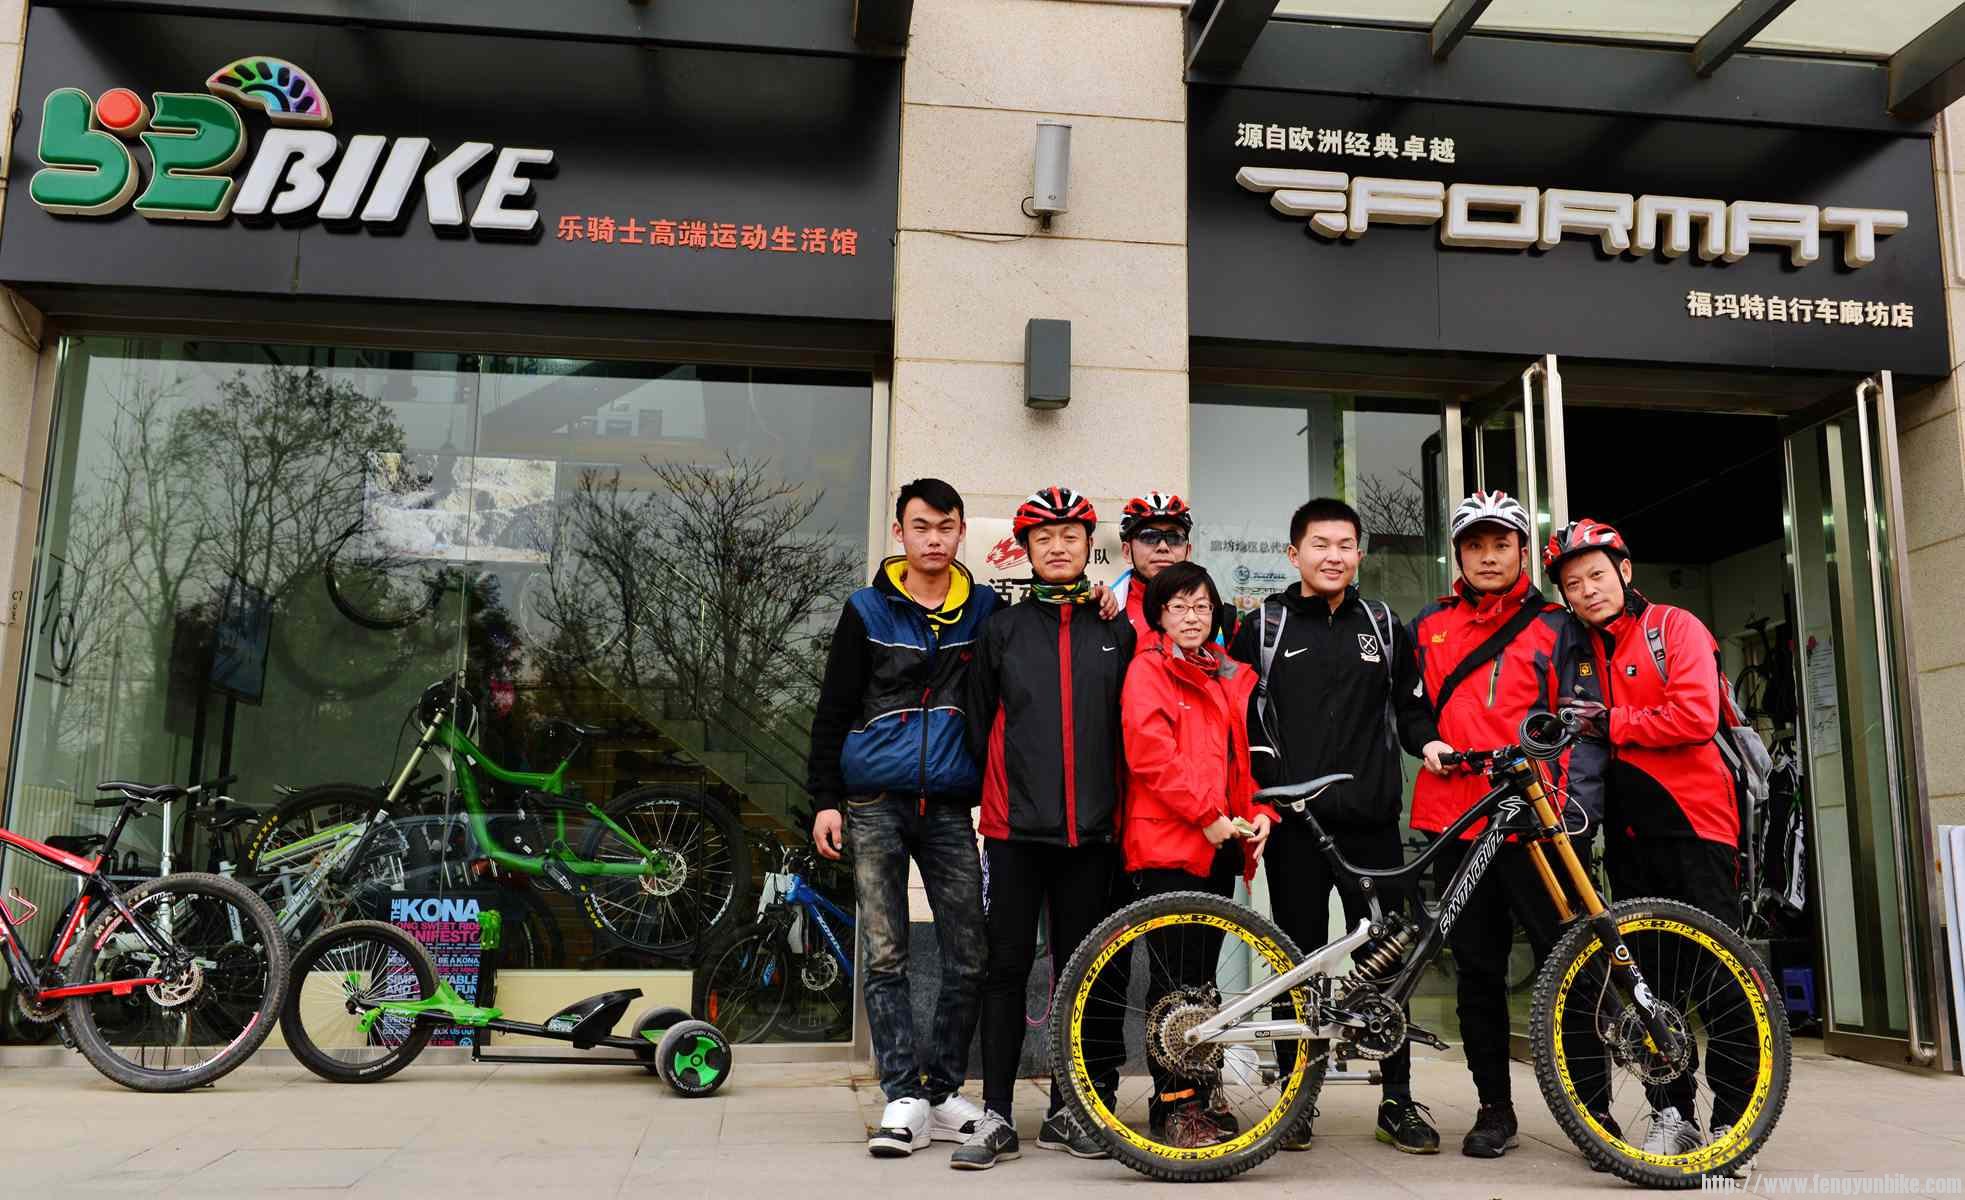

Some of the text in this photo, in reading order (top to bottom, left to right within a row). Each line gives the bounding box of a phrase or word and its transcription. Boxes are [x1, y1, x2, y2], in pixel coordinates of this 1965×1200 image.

[1235, 122, 1457, 163] 源自欧洲经典卓越
[557, 214, 859, 256] 乐骑士高端运动生活馆
[1346, 176, 1909, 268] FORMAT
[1687, 290, 1915, 328] 福玛特自行车廊坊店
[401, 898, 481, 922] KONA
[421, 922, 456, 931] SWEET
